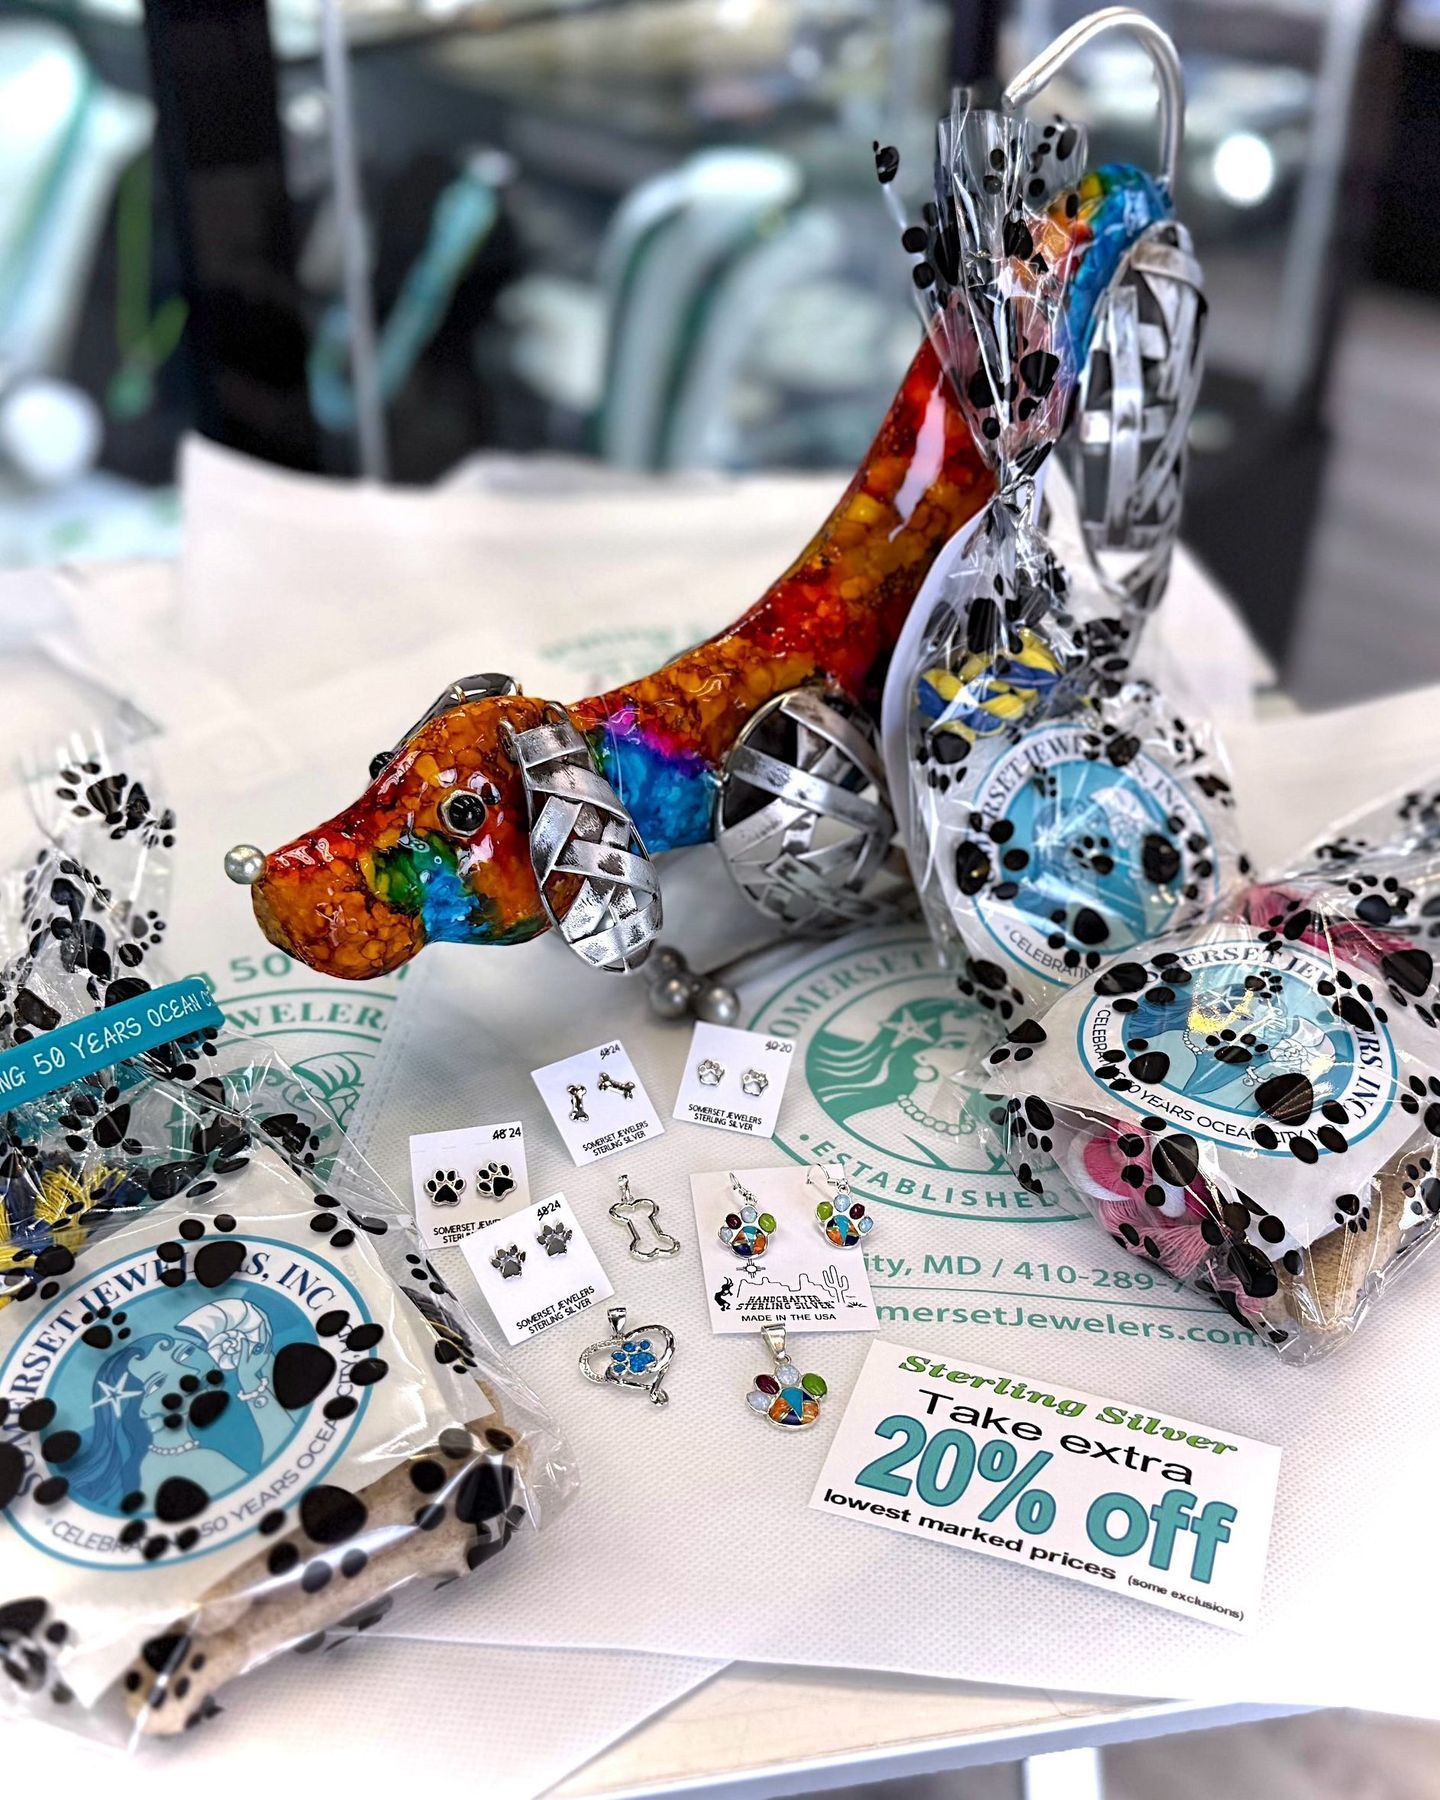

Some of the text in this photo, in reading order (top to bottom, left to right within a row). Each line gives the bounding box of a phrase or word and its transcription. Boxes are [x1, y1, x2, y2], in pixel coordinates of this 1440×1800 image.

[230, 952, 292, 983] 50
[1009, 930, 1096, 978] CELEBRATIN
[1146, 947, 1281, 983] OERSET
[33, 1047, 66, 1074] 50
[70, 1018, 142, 1059] YEARS
[147, 993, 201, 1027] OCEAN
[688, 1103, 762, 1125] SOMERSET JEWELERS
[694, 1113, 753, 1131] STERLING SILVER
[1140, 1089, 1194, 1122] YEARS
[1197, 1116, 1257, 1141] OCEA
[509, 1127, 521, 1138] 24
[582, 1120, 649, 1152] SOMERSET JEWELERS
[592, 1130, 646, 1156] STERLING SILVER
[811, 1140, 1058, 1208] ESTABLISHED
[433, 1222, 475, 1236] SOMERSET
[863, 1252, 912, 1279] ity,
[923, 1253, 981, 1276] MD
[991, 1257, 1004, 1279] /
[276, 1263, 336, 1311] INC
[747, 1295, 821, 1304] HANDCRAFTED
[516, 1285, 595, 1330] SOMERSET JEWELERS
[528, 1298, 592, 1334] STERLING SILVER
[736, 1303, 791, 1311] STERLING
[741, 1314, 772, 1322] MADE
[789, 1313, 811, 1321] THE
[814, 1313, 837, 1321] USA
[898, 1355, 1239, 1455] Sterling Silver
[918, 1388, 1194, 1486] Take extra
[200, 1516, 228, 1542] 50
[230, 1470, 301, 1523] YEARS
[298, 1415, 341, 1472] OCEA
[854, 1414, 1238, 1584] 20% off
[823, 1488, 1244, 1622] lowest marked prices (some exclusions)
